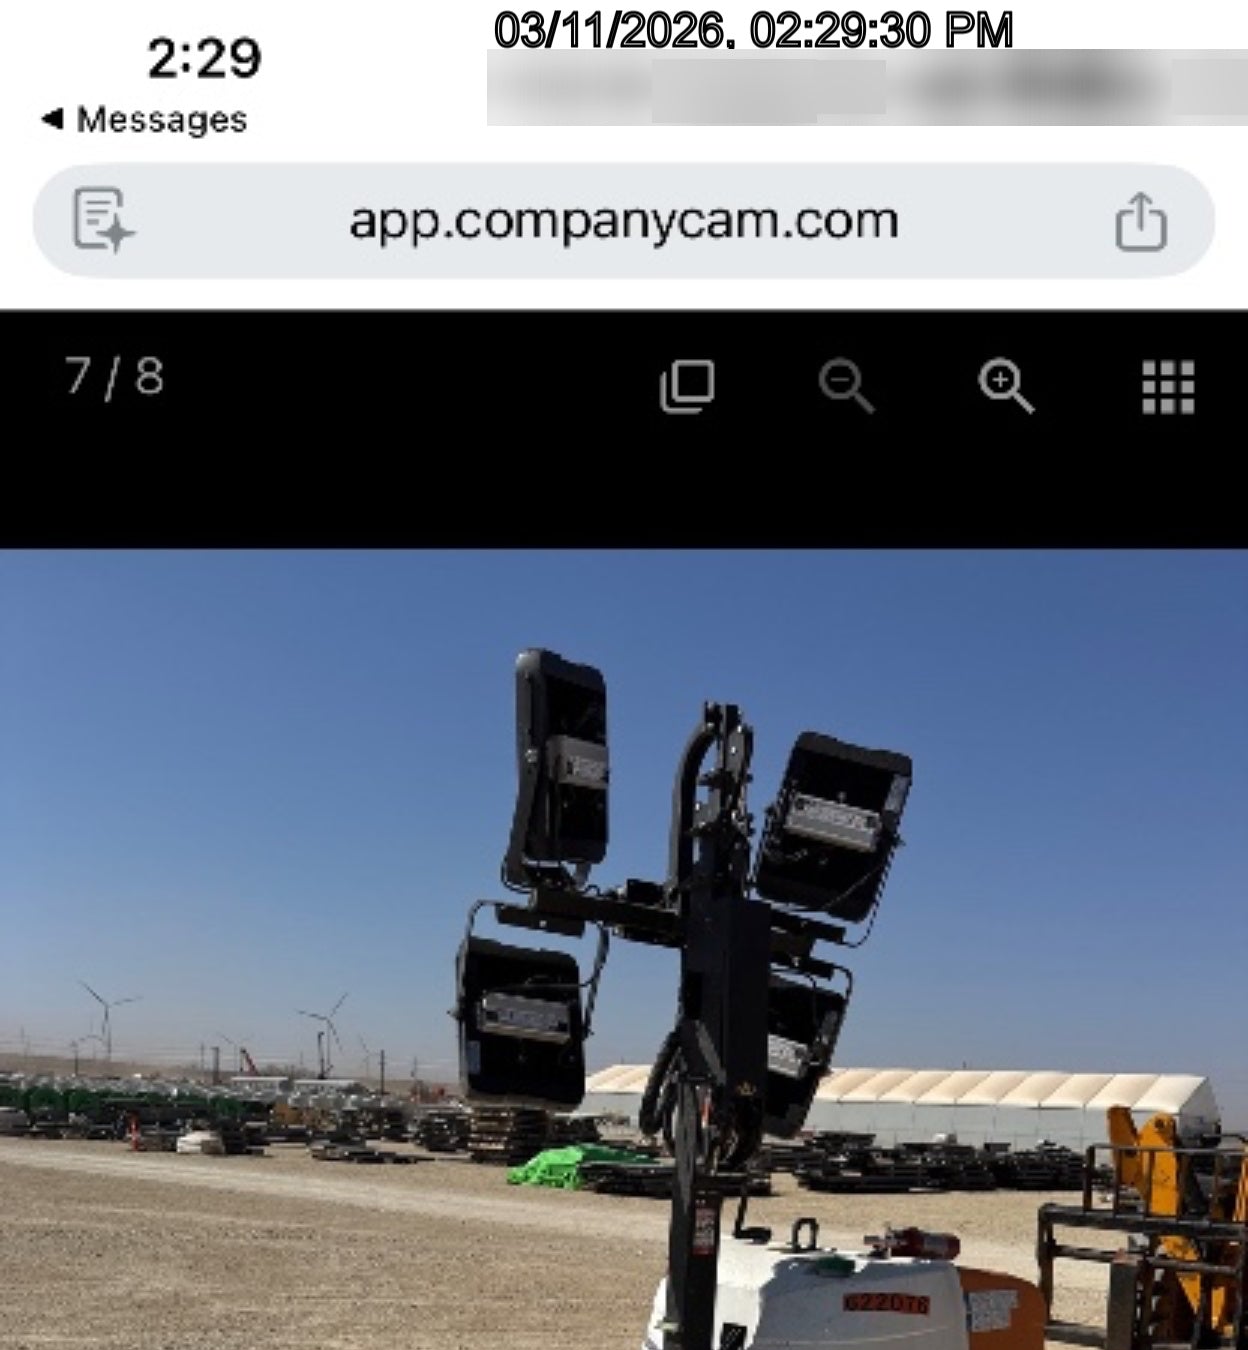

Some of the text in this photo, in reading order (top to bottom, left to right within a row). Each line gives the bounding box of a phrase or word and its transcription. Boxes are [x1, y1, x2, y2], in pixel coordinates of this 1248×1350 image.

[148, 36, 262, 79] 2:29
[77, 105, 248, 139] Messages
[349, 201, 899, 250] app.companycam.com
[65, 355, 91, 394] 7
[136, 355, 164, 394] 8
